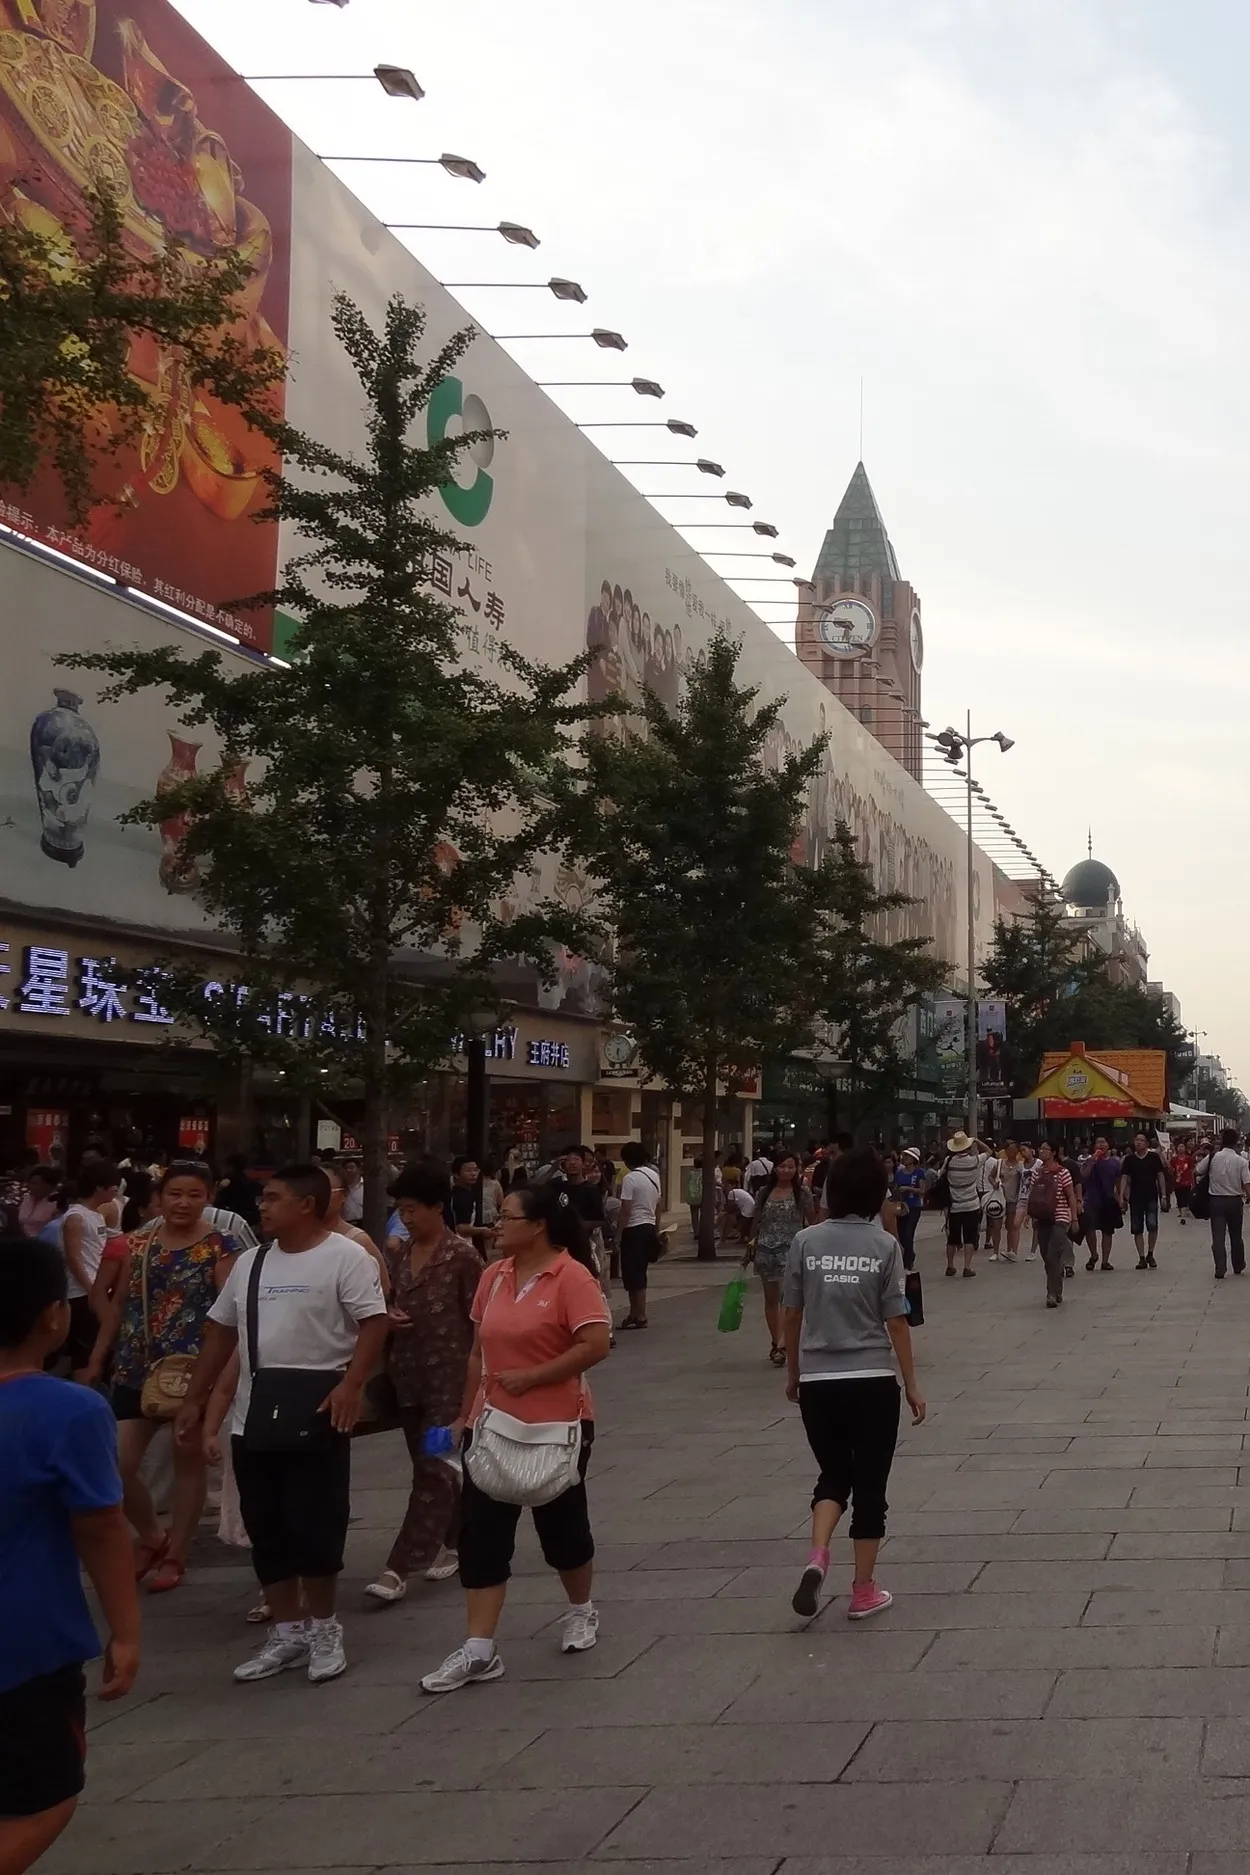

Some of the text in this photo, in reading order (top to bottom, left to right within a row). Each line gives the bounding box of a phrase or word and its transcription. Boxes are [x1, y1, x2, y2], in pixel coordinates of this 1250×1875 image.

[467, 548, 493, 583] LIFE
[418, 549, 505, 632] 国人寿
[0, 940, 175, 1024] 星珠宝
[529, 1040, 570, 1069] 王府井店
[806, 1256, 882, 1273] G-SHOCK
[824, 1275, 860, 1284] CASIO
